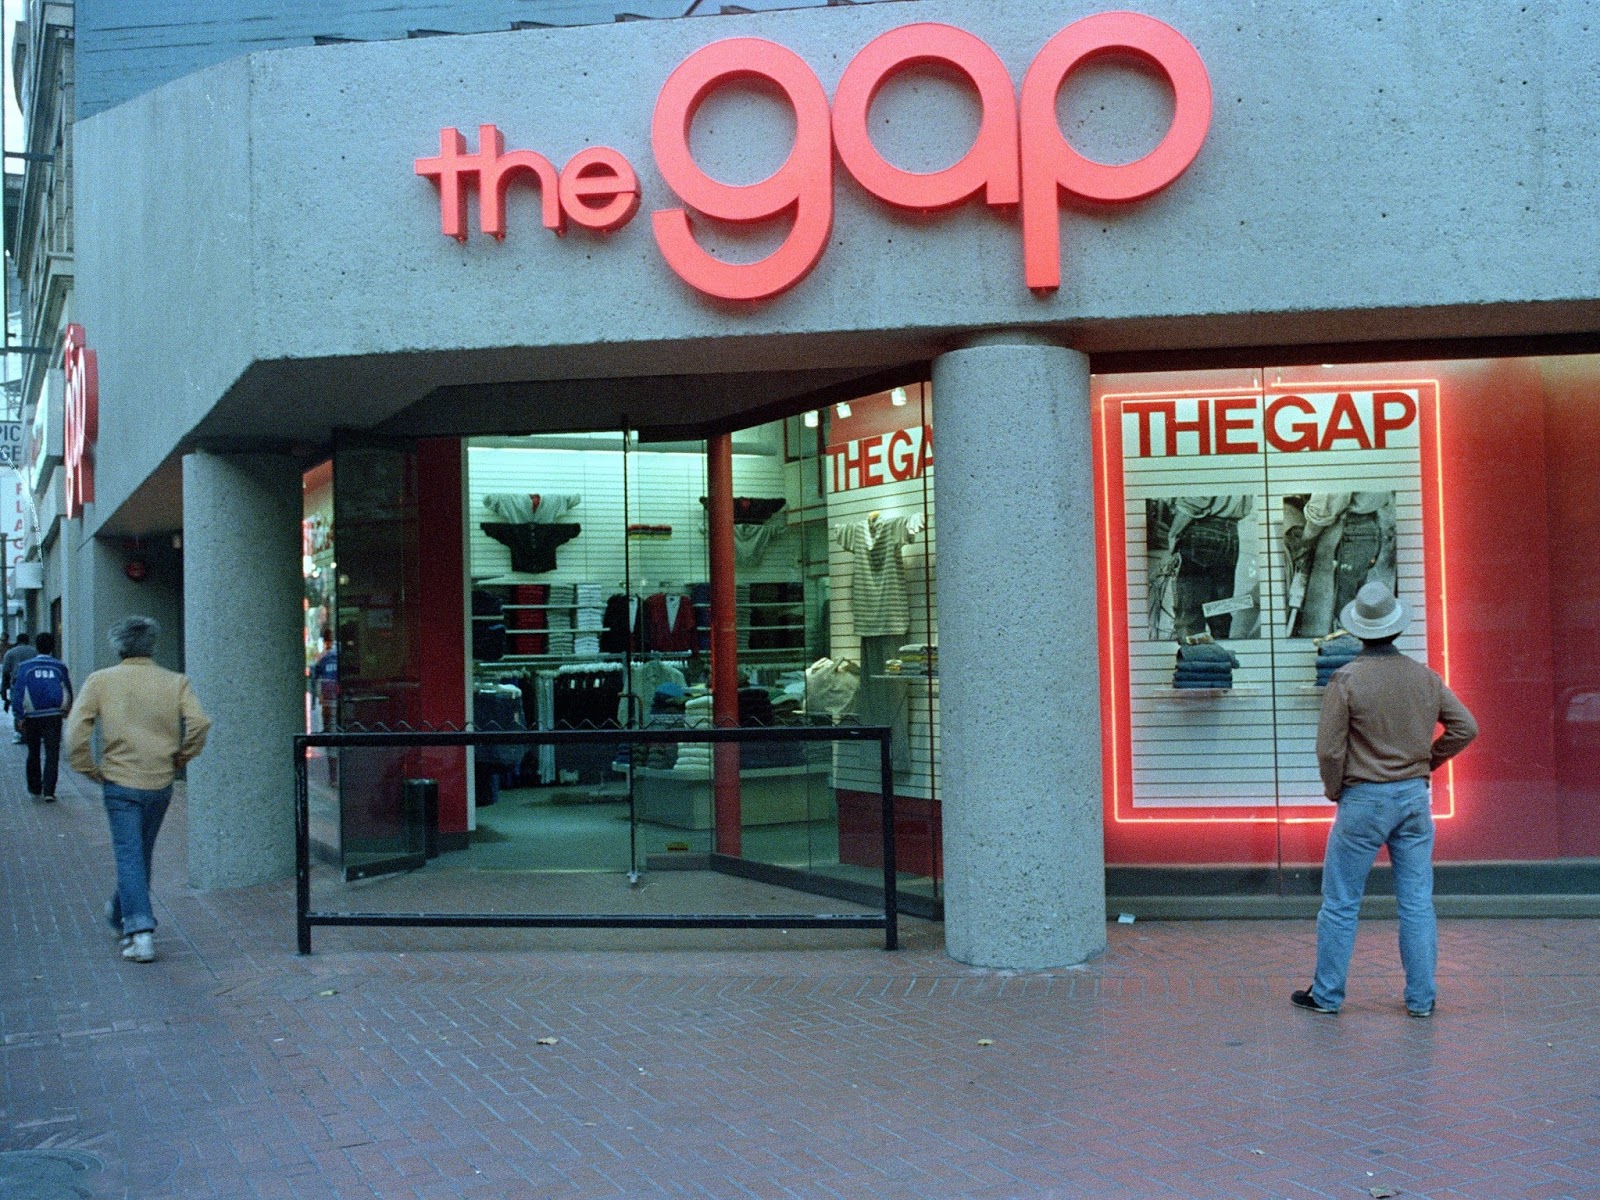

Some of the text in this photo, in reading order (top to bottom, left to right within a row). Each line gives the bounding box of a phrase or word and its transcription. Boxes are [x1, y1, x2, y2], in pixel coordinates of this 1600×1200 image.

[414, 12, 1211, 301] the gap
[0, 425, 21, 441] IC
[888, 424, 934, 481] GA
[35, 669, 55, 678] USA
